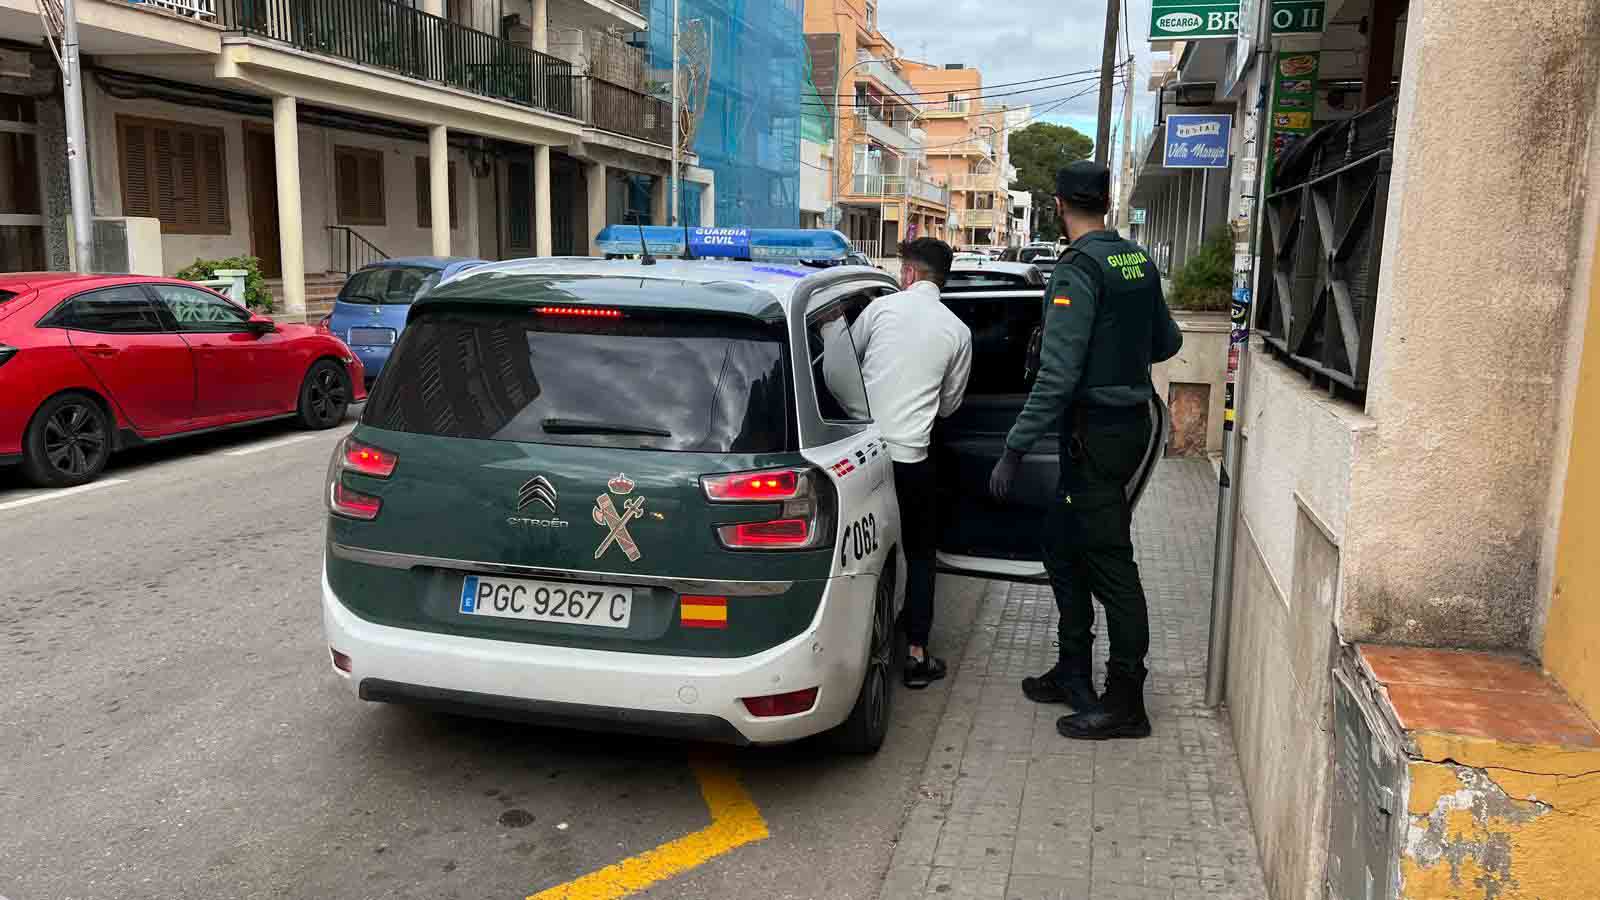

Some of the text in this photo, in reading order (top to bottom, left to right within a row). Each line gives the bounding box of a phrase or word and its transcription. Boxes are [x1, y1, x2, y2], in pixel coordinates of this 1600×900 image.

[1160, 17, 1200, 27] RECARGA
[1206, 9, 1293, 31] BRO
[1168, 142, 1188, 158] Villa
[695, 228, 746, 236] GUARDIA
[704, 235, 735, 245] CIVIL
[1107, 252, 1148, 267] GUARDIA
[1121, 265, 1145, 280] CIVIL
[853, 512, 878, 560] 062
[477, 583, 626, 621] PGC 9267 C
